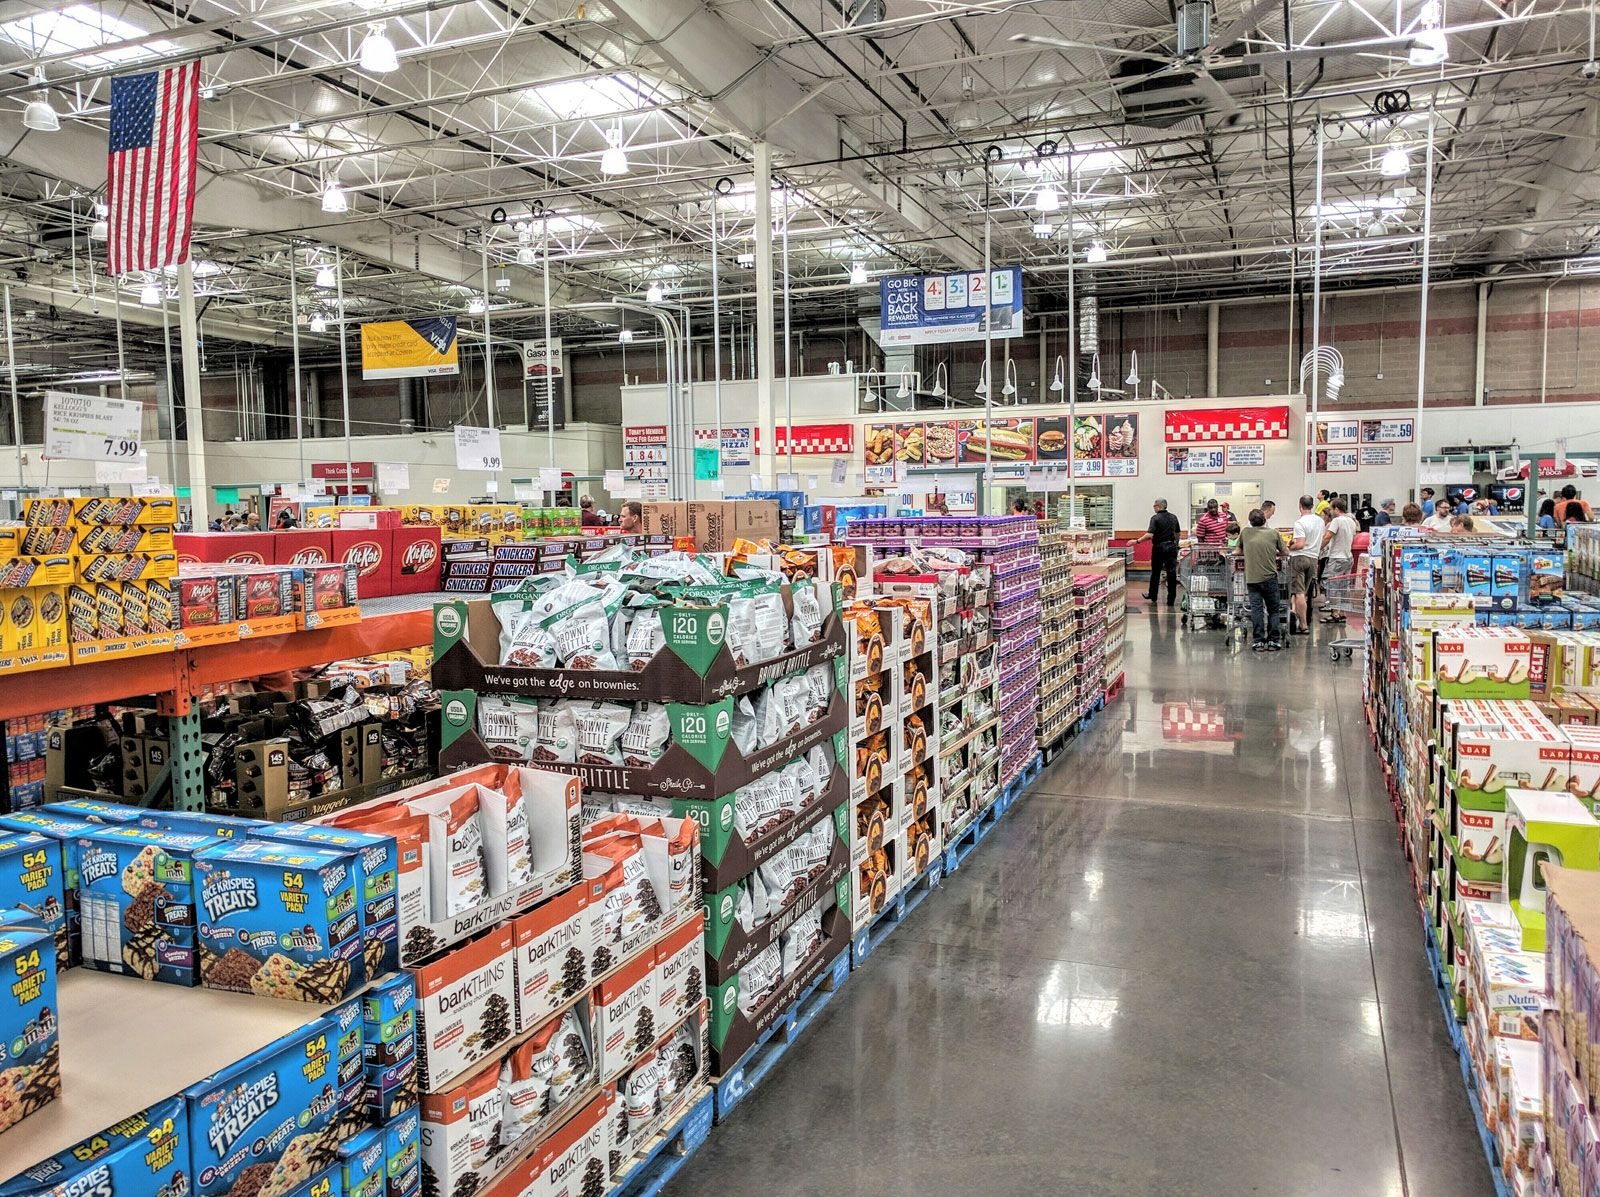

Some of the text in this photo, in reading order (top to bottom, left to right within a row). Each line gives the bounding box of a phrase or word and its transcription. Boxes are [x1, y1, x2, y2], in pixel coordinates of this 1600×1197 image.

[888, 278, 918, 289] GO BIG
[888, 292, 918, 304] CASH
[888, 302, 918, 316] BACK
[888, 314, 919, 322] REWARDS
[430, 331, 447, 352] VISA
[526, 348, 560, 358] Gasone
[1342, 426, 1357, 438] 1.00
[1397, 424, 1412, 438] .59
[104, 440, 138, 456] 7.99
[483, 456, 500, 468] 9.99
[1086, 461, 1100, 471] 3.99
[1206, 452, 1222, 467] .59
[1342, 455, 1356, 466] 1.45
[960, 492, 974, 504] 1.45
[496, 547, 535, 560] SNICKERS
[450, 562, 488, 576] SNICKERS
[494, 564, 532, 576] SNICKERS
[446, 578, 486, 590] SNICKERS
[672, 618, 698, 634] 120
[1438, 644, 1462, 652] ABAR
[1532, 645, 1544, 673] CLIF
[758, 660, 787, 686] BROWNIE
[485, 674, 640, 694] We've got the edge on brownies.
[484, 713, 518, 726] BROWNIE
[681, 717, 706, 734] 120
[52, 738, 60, 746] 145
[368, 733, 378, 743] 145
[151, 751, 162, 760] 145
[270, 753, 284, 762] 145
[752, 760, 767, 773] We've
[767, 756, 776, 766] got
[776, 750, 784, 759] the
[785, 738, 798, 758] edge
[1460, 746, 1488, 754] ABAR
[310, 796, 352, 816] Nuggets
[754, 846, 768, 860] We've
[768, 840, 778, 850] got
[778, 834, 786, 843] the
[786, 822, 798, 840] edge
[22, 850, 46, 868] 54
[82, 854, 117, 870] RICE KRISPIES
[364, 852, 390, 876] TREATS
[20, 866, 53, 884] VARIETY
[82, 862, 118, 886] TREATS
[283, 872, 304, 889] 54
[324, 870, 347, 896] TREATS
[26, 878, 48, 892] PACK
[202, 877, 256, 901] RICE KRISPIES
[204, 890, 258, 922] TREATS
[280, 891, 310, 904] VARIETY
[164, 906, 189, 920] TREATS
[286, 902, 305, 914] PACK
[454, 896, 513, 935] barkTHINS
[336, 918, 358, 942] TREATS
[622, 922, 659, 954] barkTHINS
[250, 936, 278, 951] TREATS
[528, 920, 582, 964] barkTHINS
[16, 949, 41, 975] 54
[663, 941, 699, 980] barkTHINS
[12, 969, 46, 996] VARIETY
[439, 960, 507, 1015] barkTHINS
[19, 985, 42, 1006] PACK
[609, 979, 652, 1024] barkTHINS
[779, 994, 787, 1008] the
[788, 980, 800, 999] edge
[306, 1034, 326, 1059] 54
[302, 1052, 331, 1076] VARIETY
[308, 1068, 326, 1084] PACK
[209, 1072, 278, 1141] RICE KRISPIES
[122, 1120, 150, 1138] PACK
[210, 1084, 279, 1159] TREATS
[147, 1118, 174, 1144] 54
[266, 1122, 296, 1153] TREATS
[72, 1136, 110, 1161] 54
[145, 1135, 179, 1166] VARIETY
[550, 1130, 600, 1185] barkTHINS
[152, 1152, 174, 1174] PACK
[310, 1178, 330, 1197] 54
